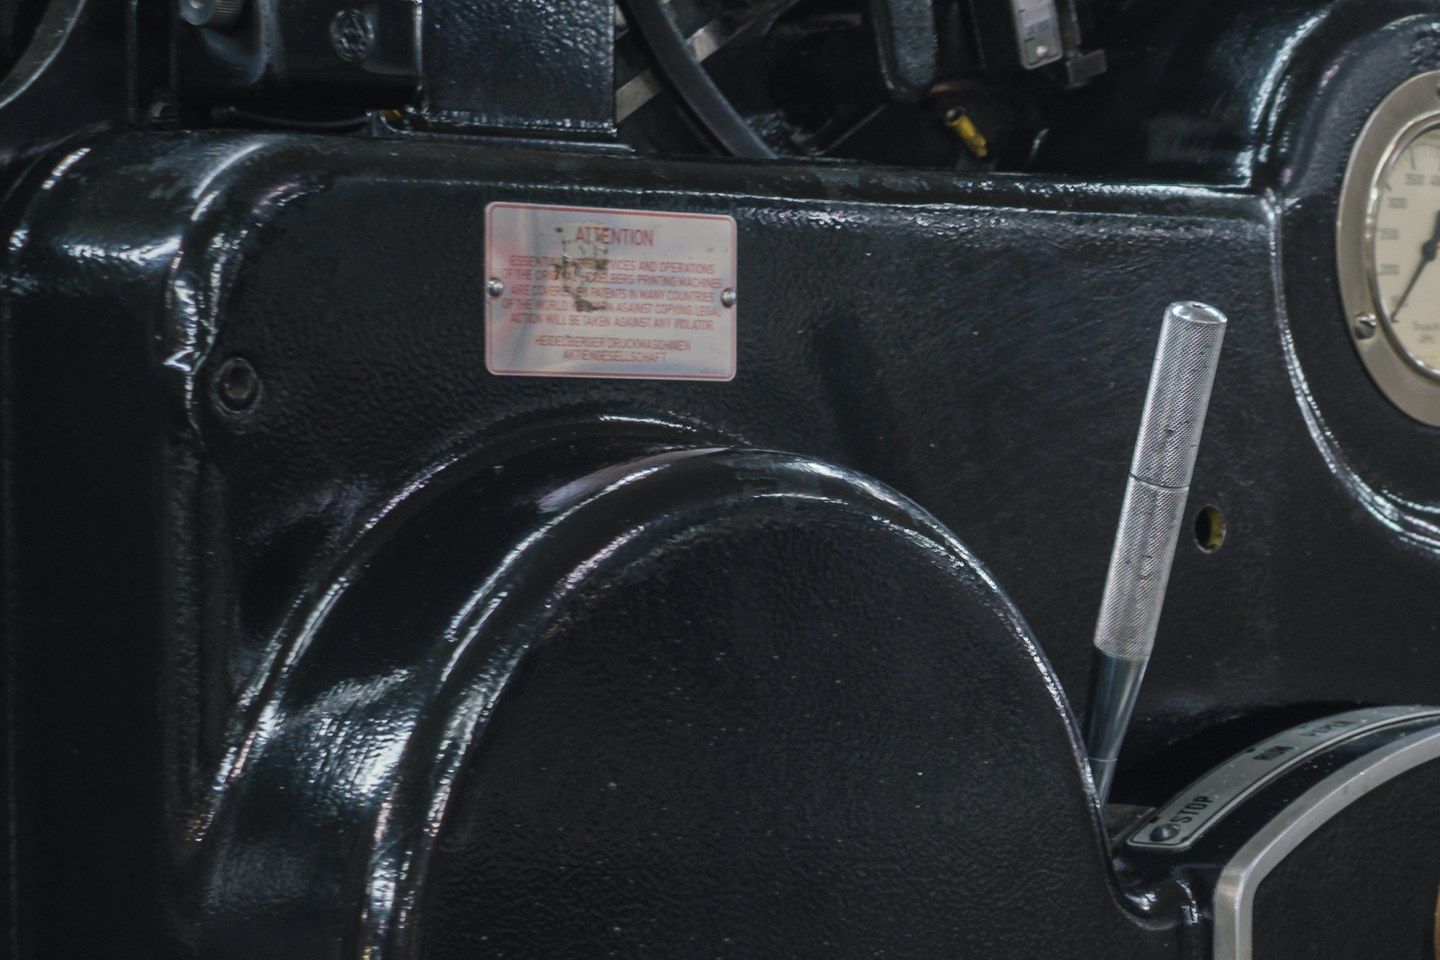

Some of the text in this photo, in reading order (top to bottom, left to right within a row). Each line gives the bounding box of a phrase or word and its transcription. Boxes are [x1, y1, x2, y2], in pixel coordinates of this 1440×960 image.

[575, 226, 654, 247] ATTENTION
[639, 260, 656, 272] AND
[660, 262, 714, 275] OPERATIONS
[638, 275, 675, 286] PRINTING
[679, 277, 722, 289] MACHINES
[590, 287, 626, 299] PATENTS
[640, 289, 664, 300] MANY
[667, 290, 714, 302] COUNTRIES
[616, 302, 653, 314] AGAINST
[655, 304, 692, 315] COPYING
[695, 306, 721, 317] LEGAL
[510, 312, 714, 331] ACTION WILL BE TAKEN AGAINST ANY VIOLATOR
[535, 334, 692, 350] HEIDELBERGER DRUCKMASCHINEN
[1170, 796, 1213, 823] STOP
